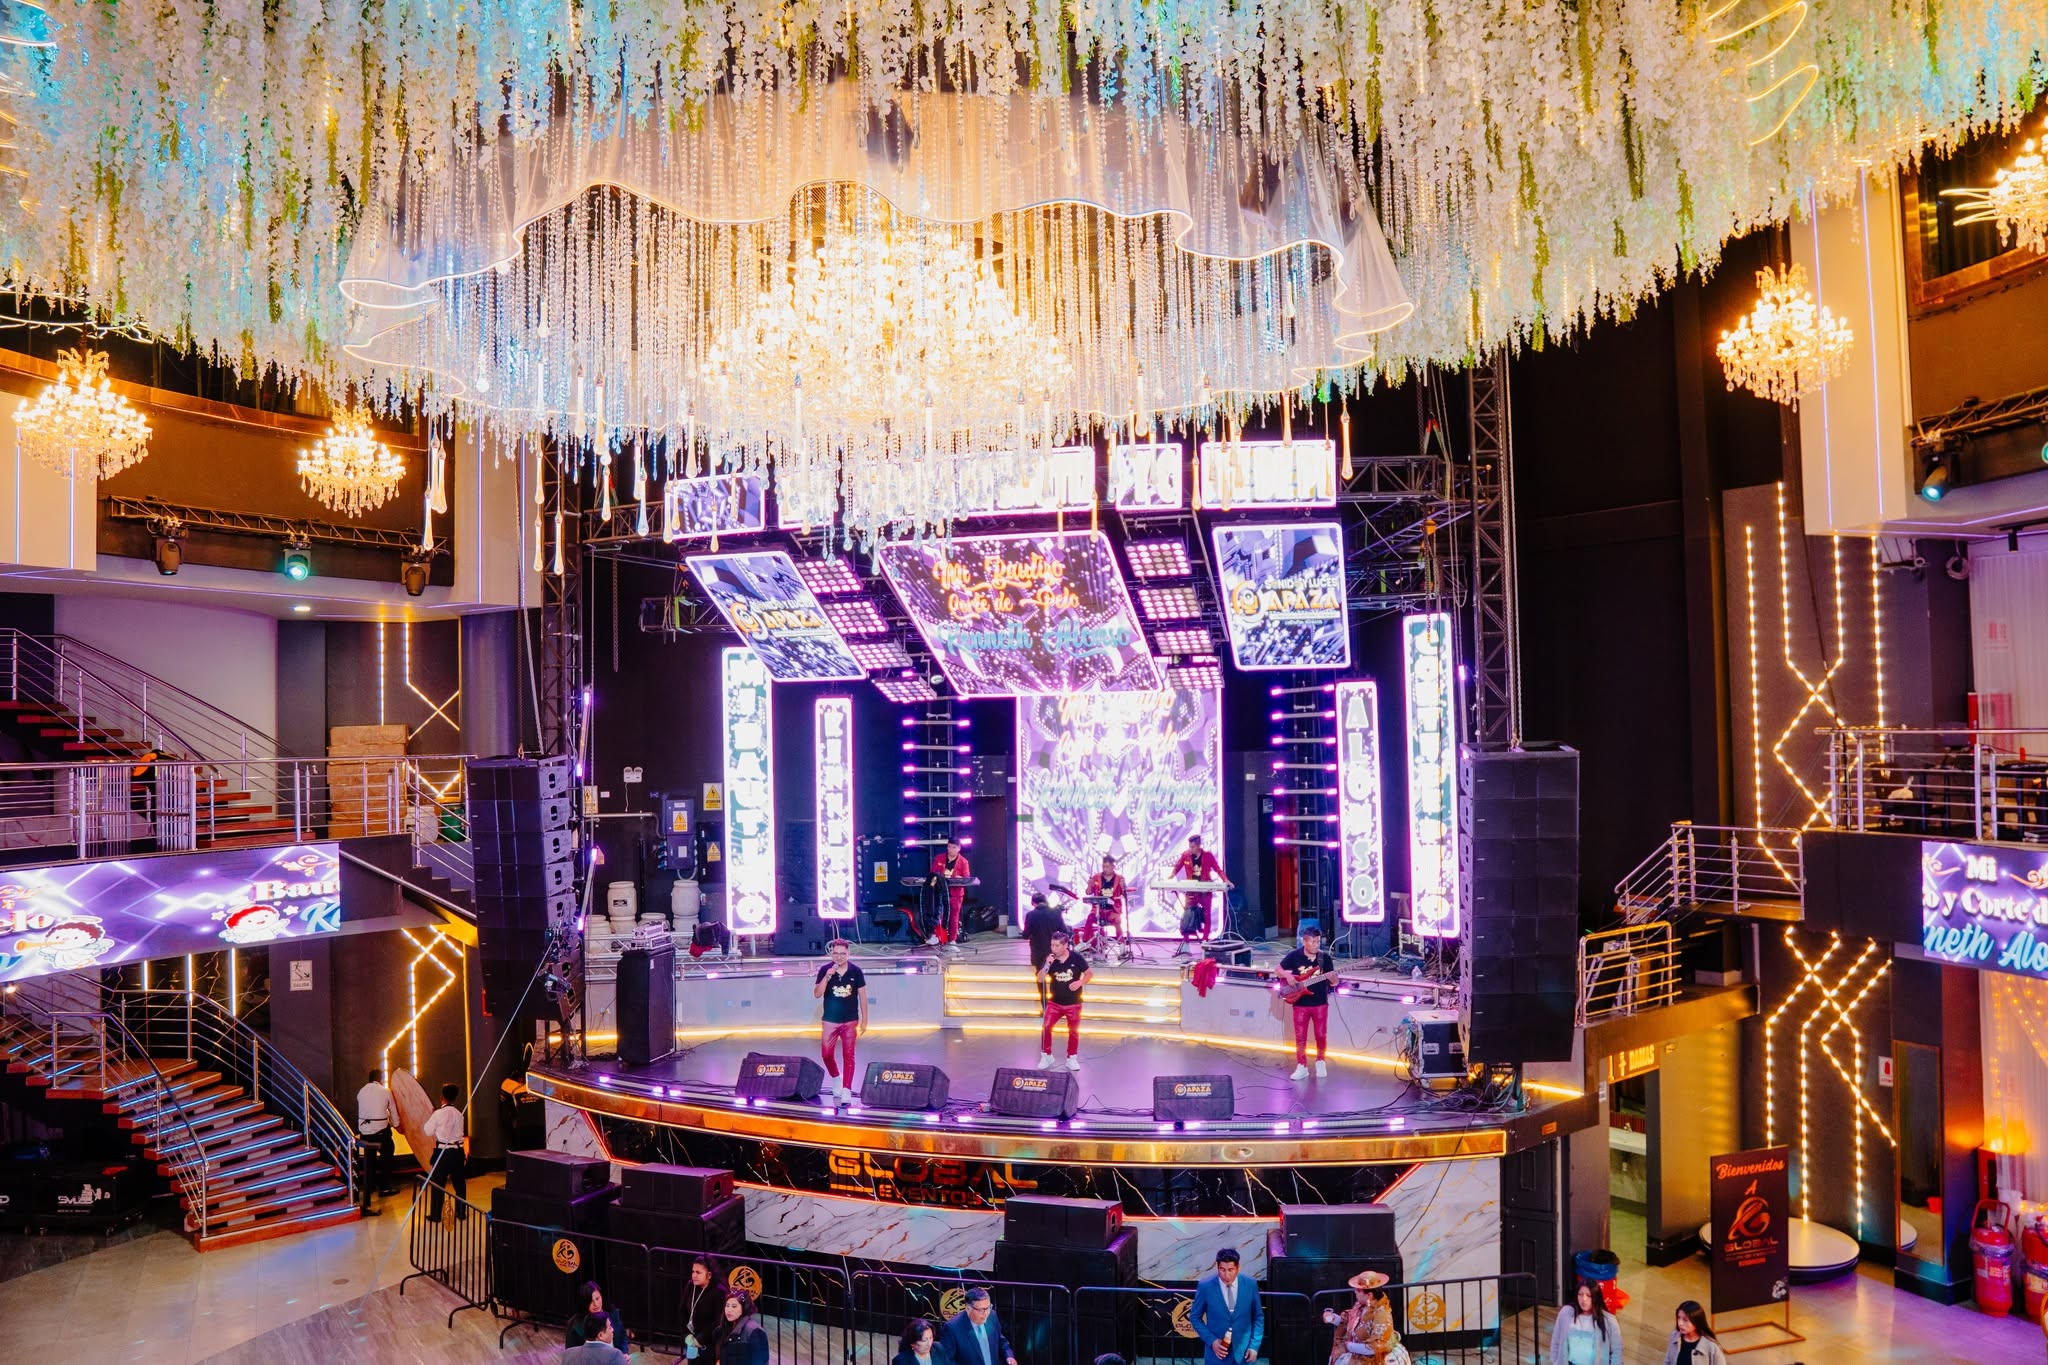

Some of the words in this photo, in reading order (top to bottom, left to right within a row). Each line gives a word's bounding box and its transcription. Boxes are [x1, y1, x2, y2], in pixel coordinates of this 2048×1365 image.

[1309, 576, 1338, 588] LUCES
[948, 593, 990, 620] Corte
[994, 593, 1013, 613] de
[1267, 589, 1340, 611] APAZA
[762, 610, 824, 629] APAZA
[938, 619, 1033, 659] Kenneth
[1043, 618, 1131, 657] Alonso
[1345, 697, 1376, 907] ALONSO
[1966, 854, 1997, 882] Mi
[1942, 891, 1958, 917] y
[1961, 887, 2029, 921] Corte
[1629, 1044, 1655, 1071] DAMAS
[828, 1149, 1038, 1190] GLOBAL
[1716, 1158, 1784, 1180] Bienvenidos
[879, 1183, 982, 1206] EVENTOS
[1744, 1179, 1758, 1196] A
[1724, 1236, 1779, 1253] GLOBAL
